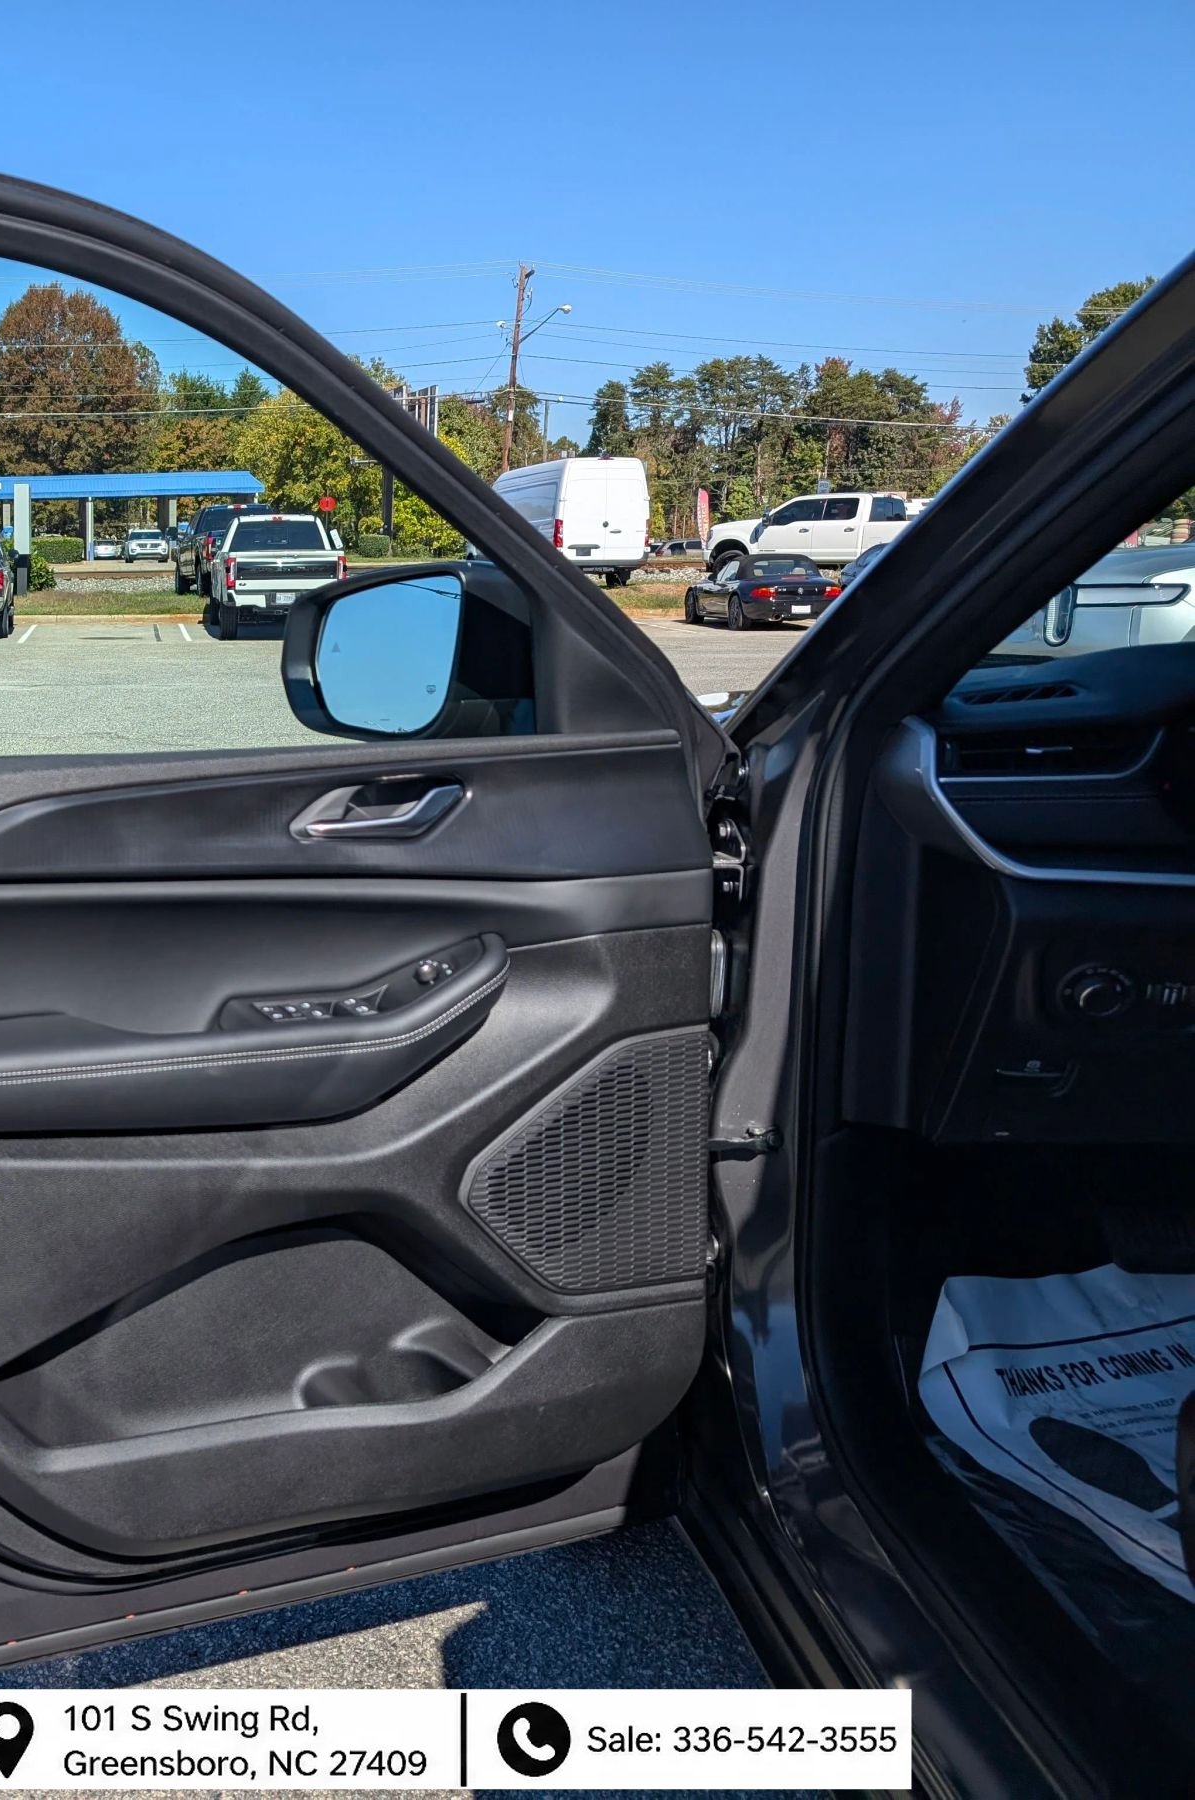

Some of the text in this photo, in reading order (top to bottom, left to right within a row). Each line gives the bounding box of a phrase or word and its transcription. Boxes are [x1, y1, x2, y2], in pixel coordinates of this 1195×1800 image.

[995, 1365, 1066, 1398] THANKS
[1058, 1360, 1104, 1387] FOR
[1097, 1349, 1174, 1380] COMING
